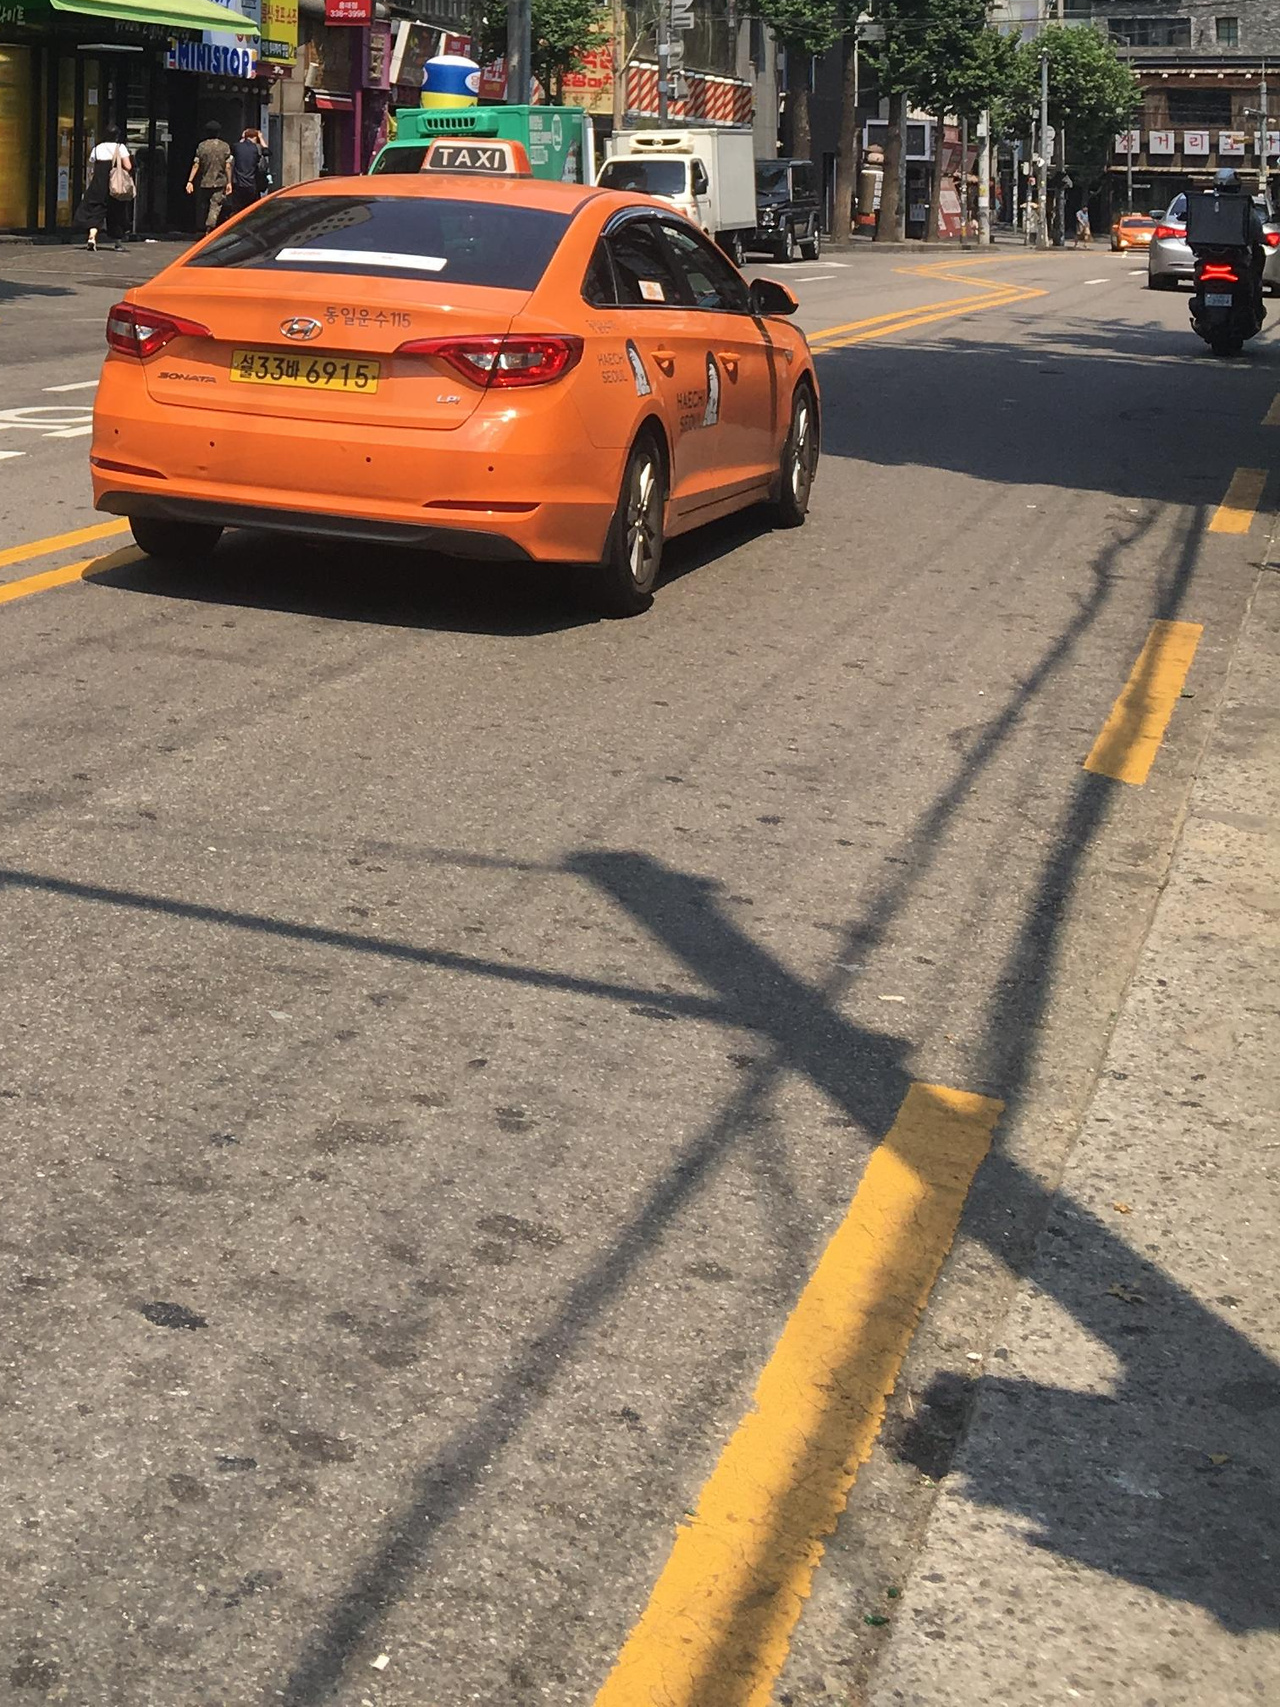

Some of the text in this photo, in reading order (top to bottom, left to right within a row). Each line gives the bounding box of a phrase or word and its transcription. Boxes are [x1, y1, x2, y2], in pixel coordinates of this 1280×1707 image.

[177, 43, 251, 78] MINISTOP
[438, 148, 500, 169] TAXI
[323, 306, 412, 328] 동일운수115
[157, 371, 217, 384] SONATA
[305, 358, 370, 389] 6915
